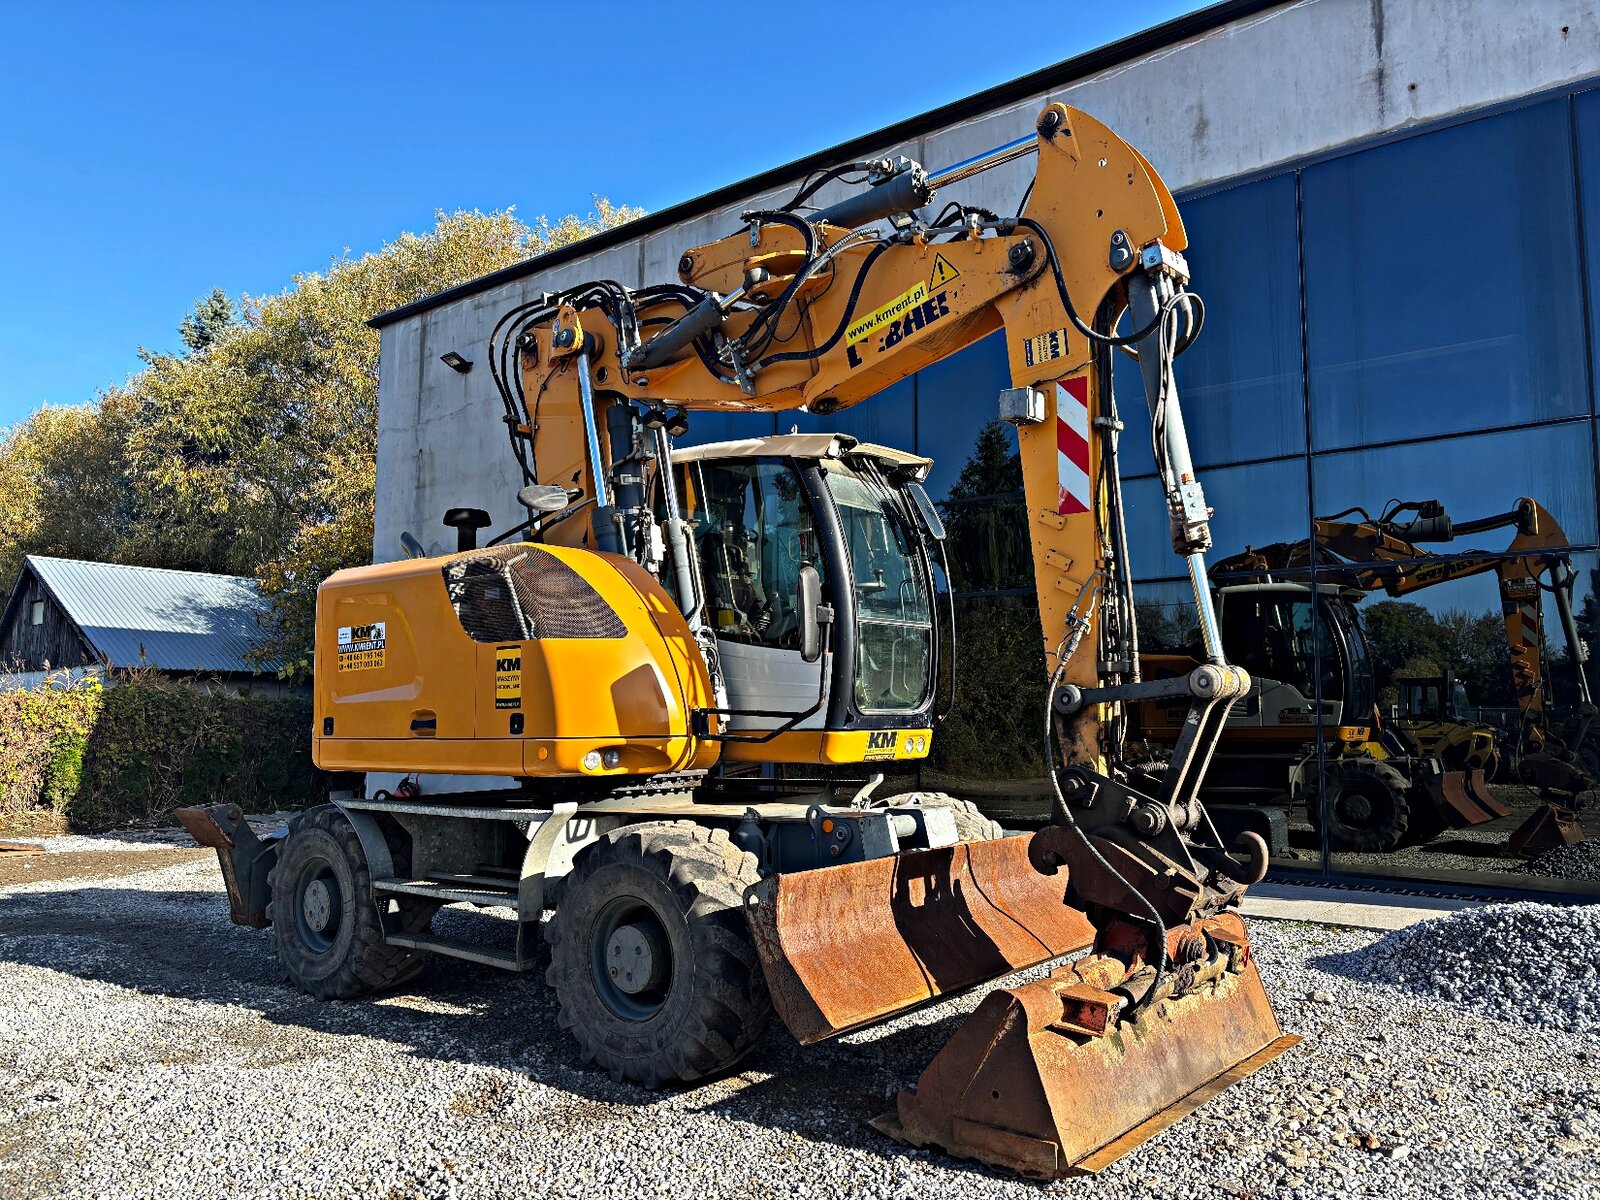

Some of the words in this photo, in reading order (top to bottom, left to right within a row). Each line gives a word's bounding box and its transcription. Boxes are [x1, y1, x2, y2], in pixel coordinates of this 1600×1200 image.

[847, 285, 925, 340] www.kmrent.pl
[1049, 330, 1060, 360] KM
[351, 626, 370, 639] KM
[338, 641, 385, 653] WWW.KMRENT.PL
[496, 658, 520, 671] KM
[868, 731, 898, 749] KM
